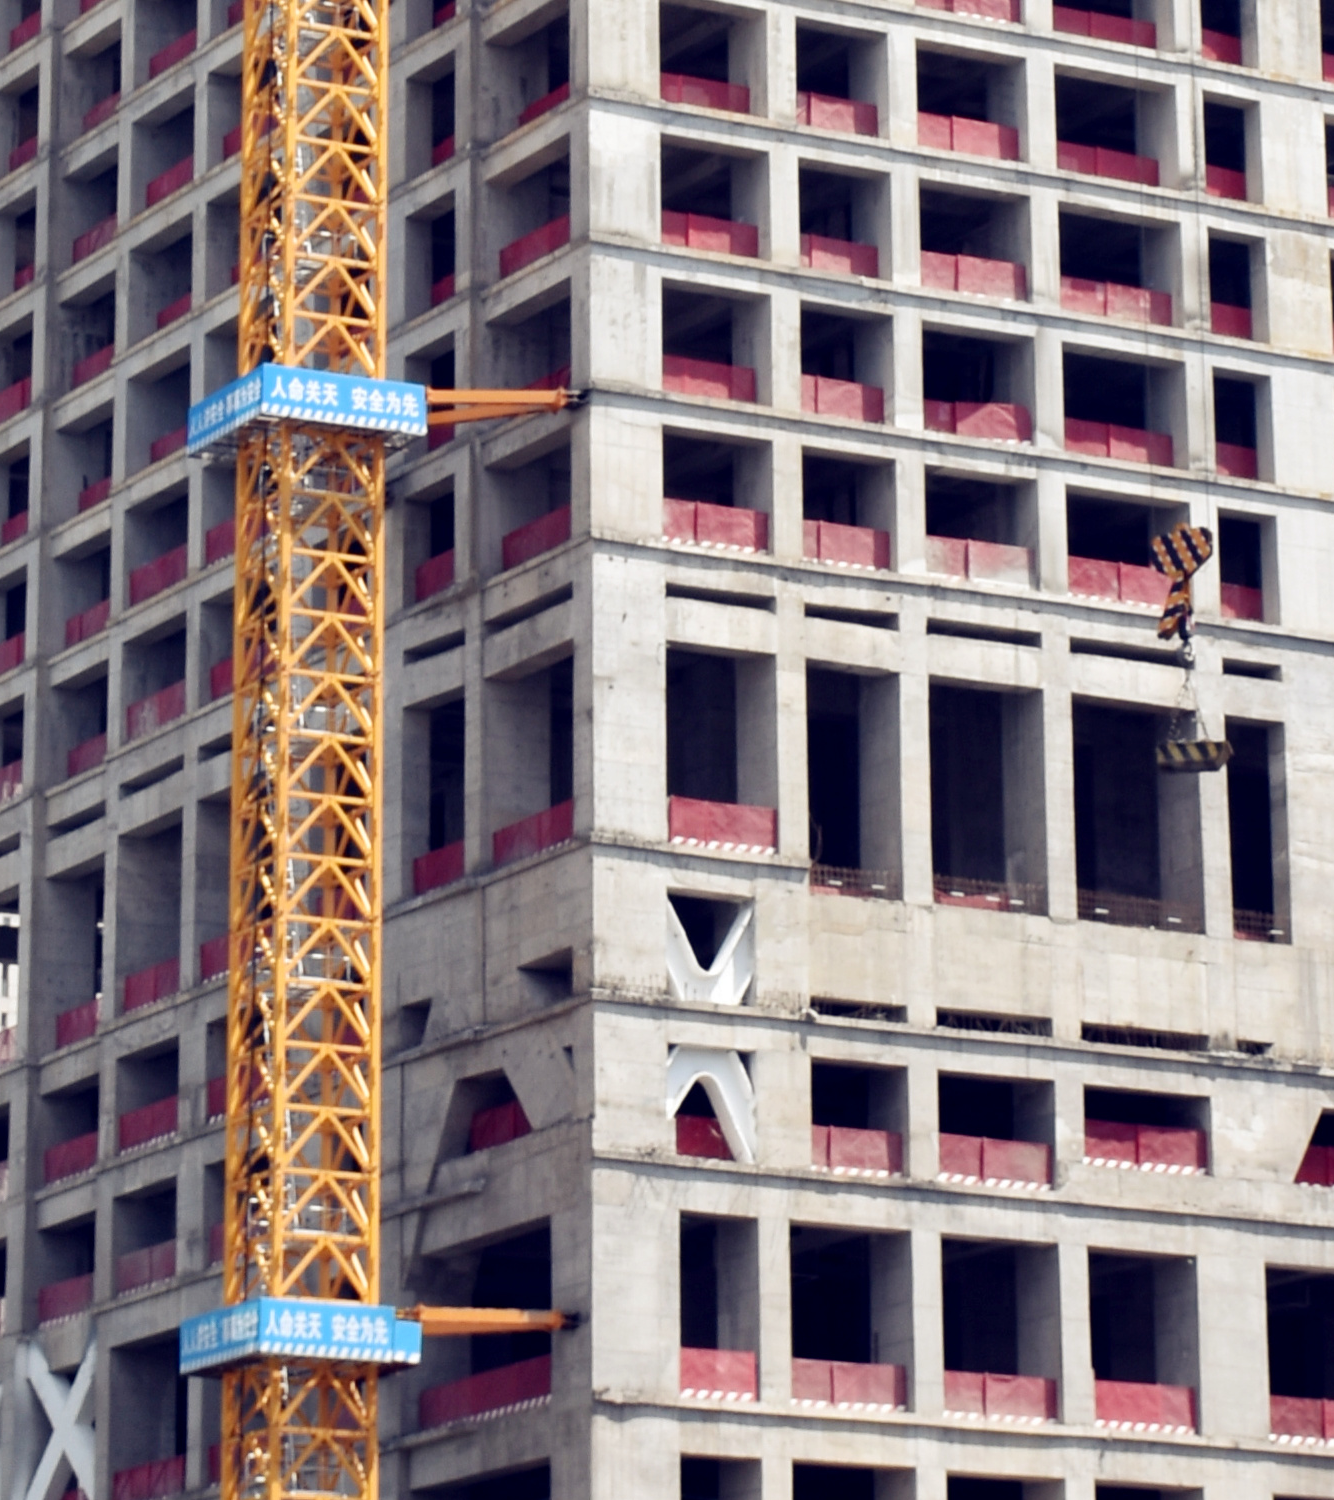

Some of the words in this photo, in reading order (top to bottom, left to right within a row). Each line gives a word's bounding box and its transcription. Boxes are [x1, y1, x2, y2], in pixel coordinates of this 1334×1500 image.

[270, 375, 340, 407] 人命关天
[351, 386, 420, 418] 安全为先
[265, 1308, 323, 1340] 人命关天
[331, 1313, 389, 1346] 安全为先
